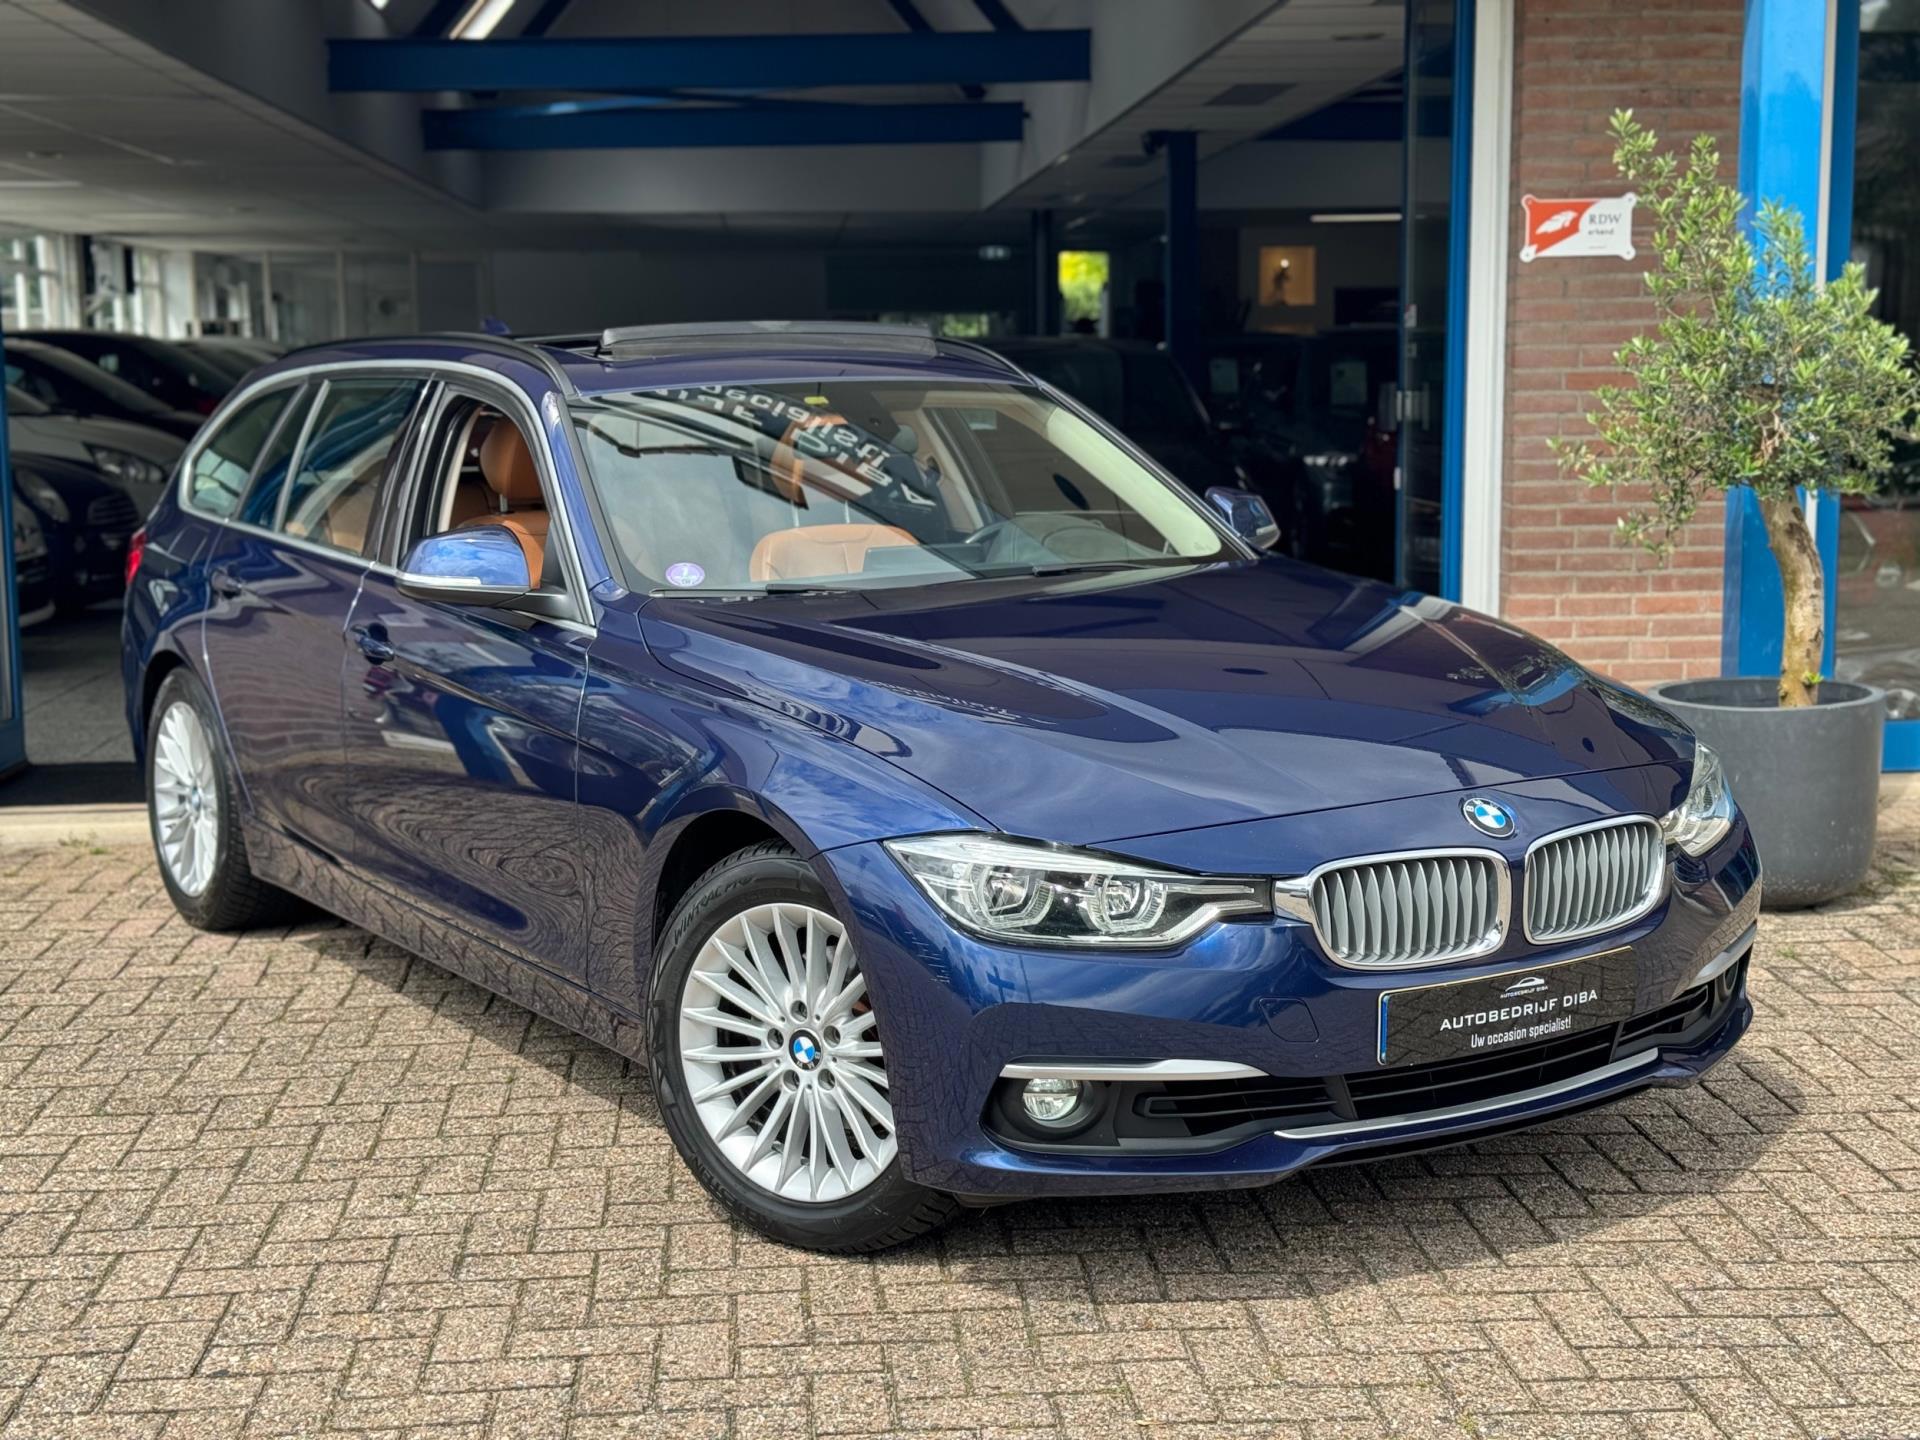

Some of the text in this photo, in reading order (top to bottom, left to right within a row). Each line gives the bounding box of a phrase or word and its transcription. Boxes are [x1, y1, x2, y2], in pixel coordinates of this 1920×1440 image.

[1588, 213, 1622, 225] RDW
[1439, 989, 1598, 1031] AUTOBEDRIJF DIBA
[1471, 1015, 1572, 1048] Uw occasion specialist!
